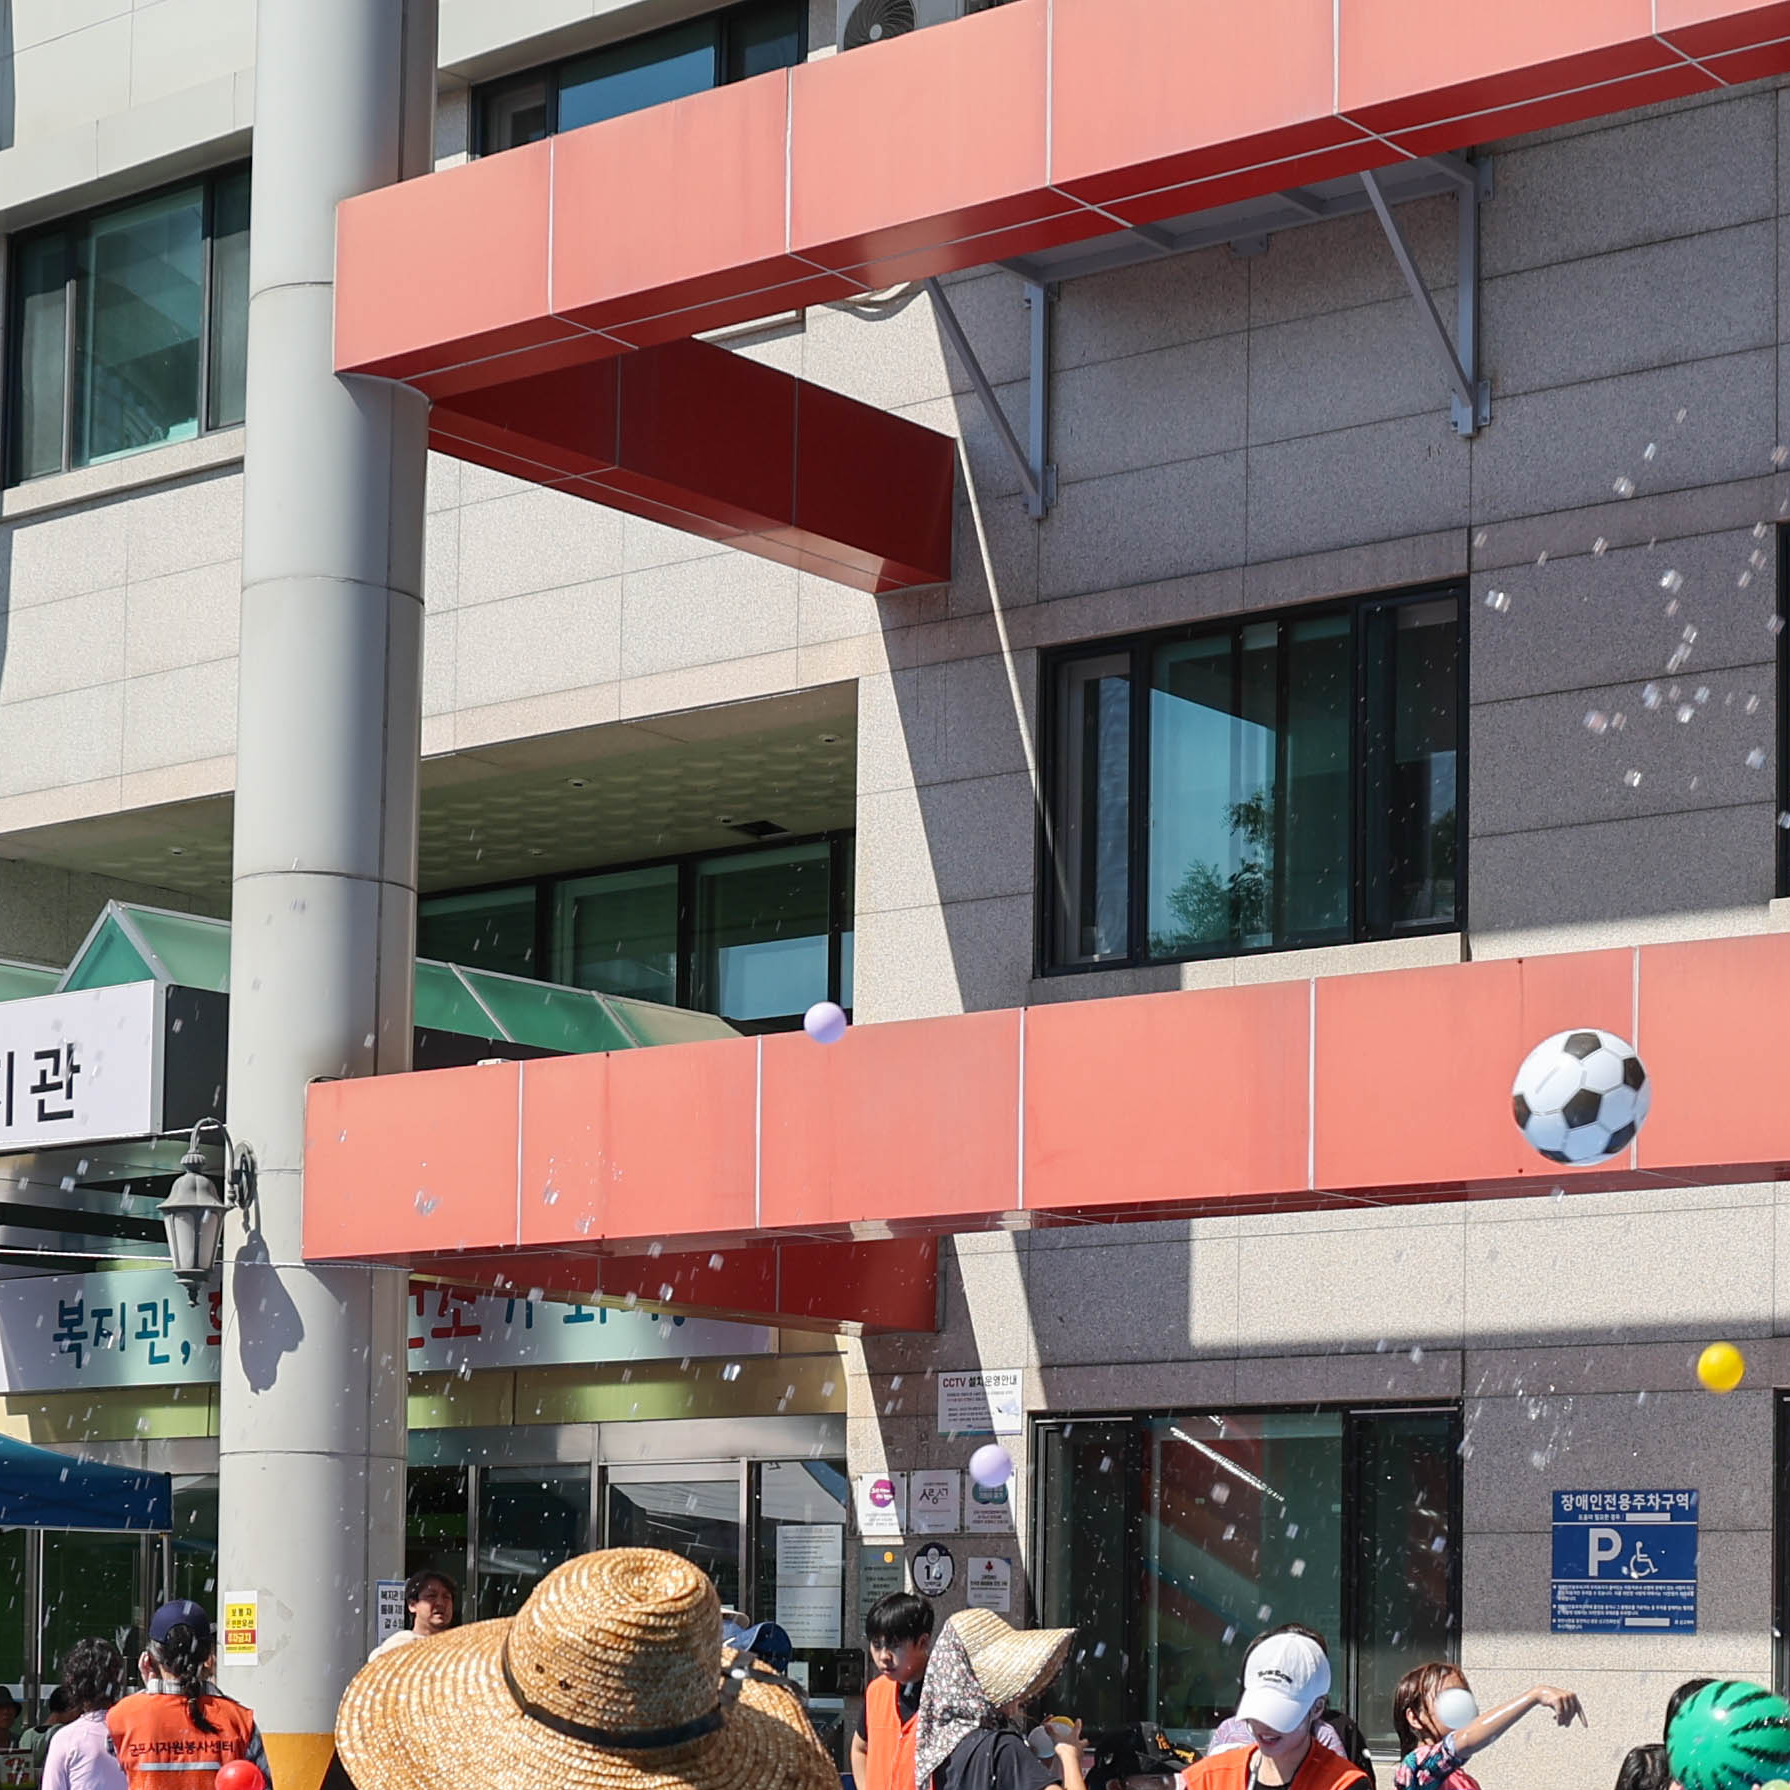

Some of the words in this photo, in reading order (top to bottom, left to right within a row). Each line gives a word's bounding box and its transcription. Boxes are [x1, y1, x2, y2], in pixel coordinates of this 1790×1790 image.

[53, 1298, 191, 1369] 복지관,
[942, 1377, 967, 1388] CCTV
[1561, 1493, 1689, 1511] 장애인전용주차구역
[1588, 1528, 1622, 1577] P
[130, 1740, 235, 1757] 군포시자원봉사센터
